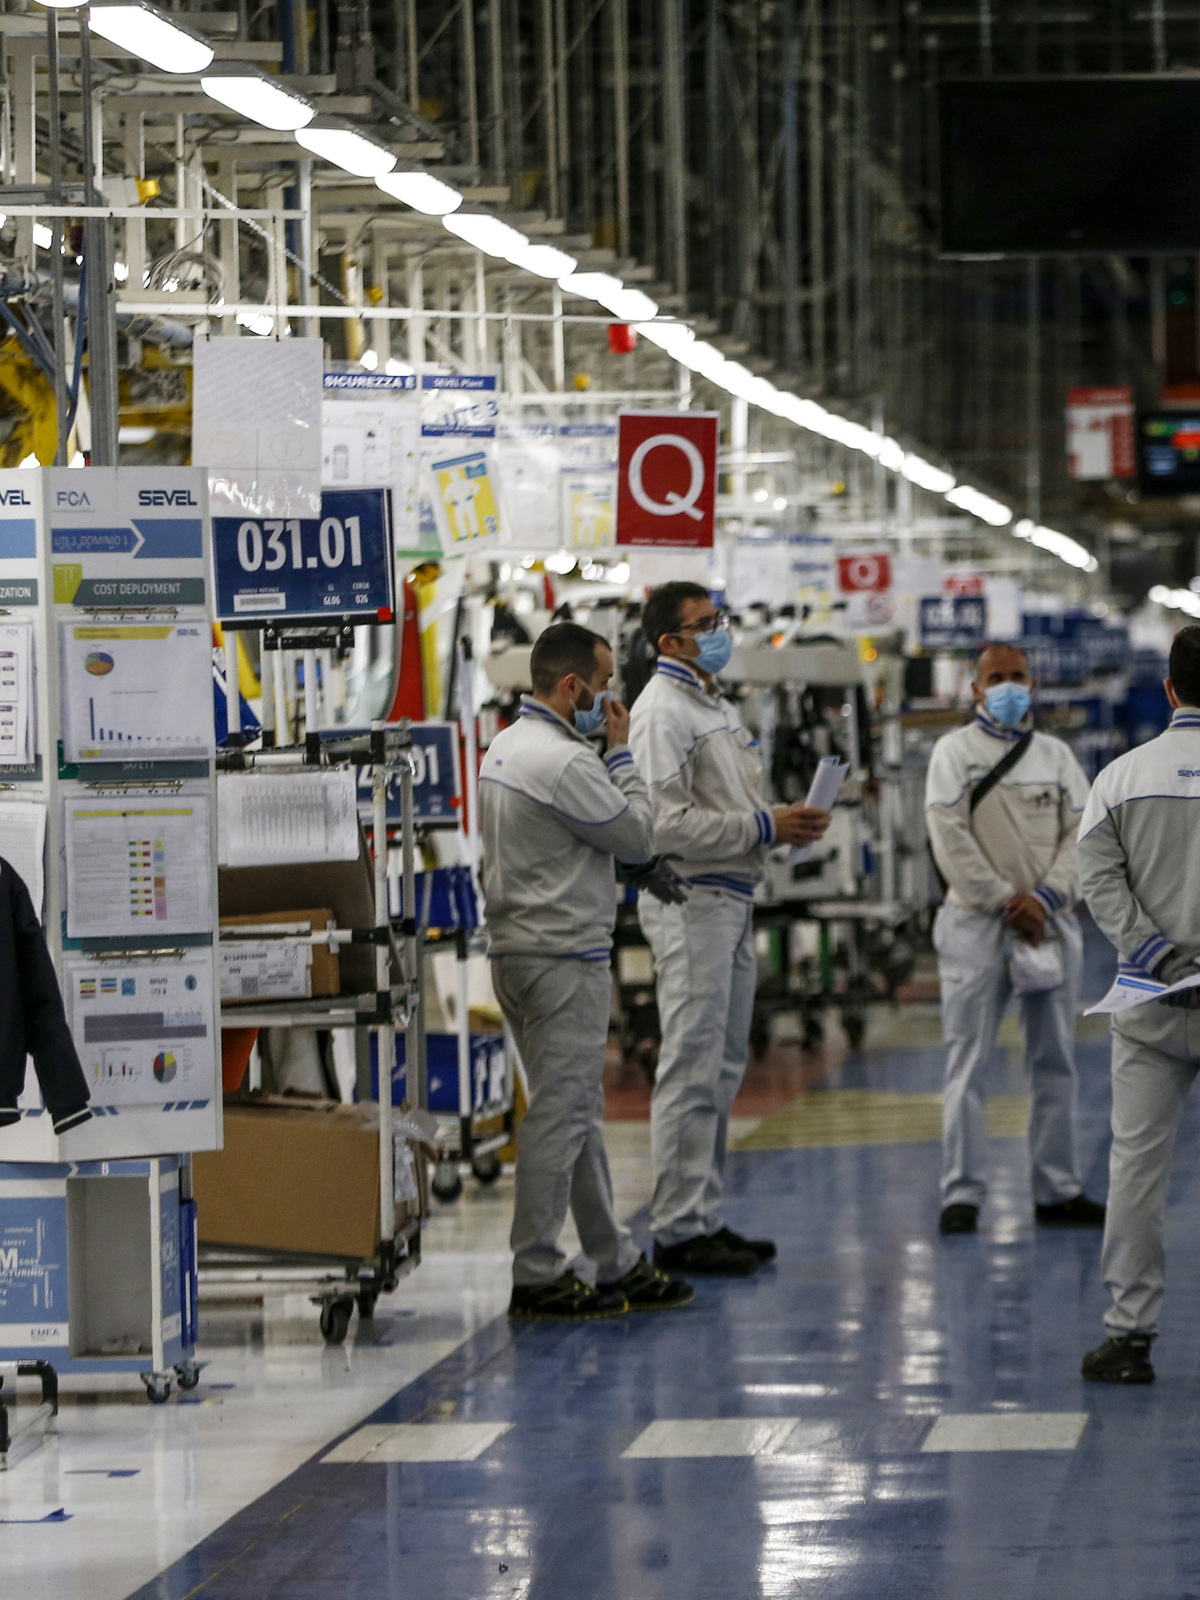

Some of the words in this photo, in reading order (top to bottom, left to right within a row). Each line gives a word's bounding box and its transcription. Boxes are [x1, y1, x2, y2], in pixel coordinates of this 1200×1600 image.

[323, 376, 403, 388] SICUREZZA
[487, 401, 499, 417] 3
[628, 433, 705, 522] Q
[57, 491, 91, 506] FCA
[138, 490, 198, 506] SEVEL
[80, 535, 121, 546] DOMINIO
[237, 515, 362, 572] 031.01
[93, 584, 119, 595] COST
[120, 582, 181, 595] DEPLOYMENT
[30, 1328, 59, 1337] EMEA
